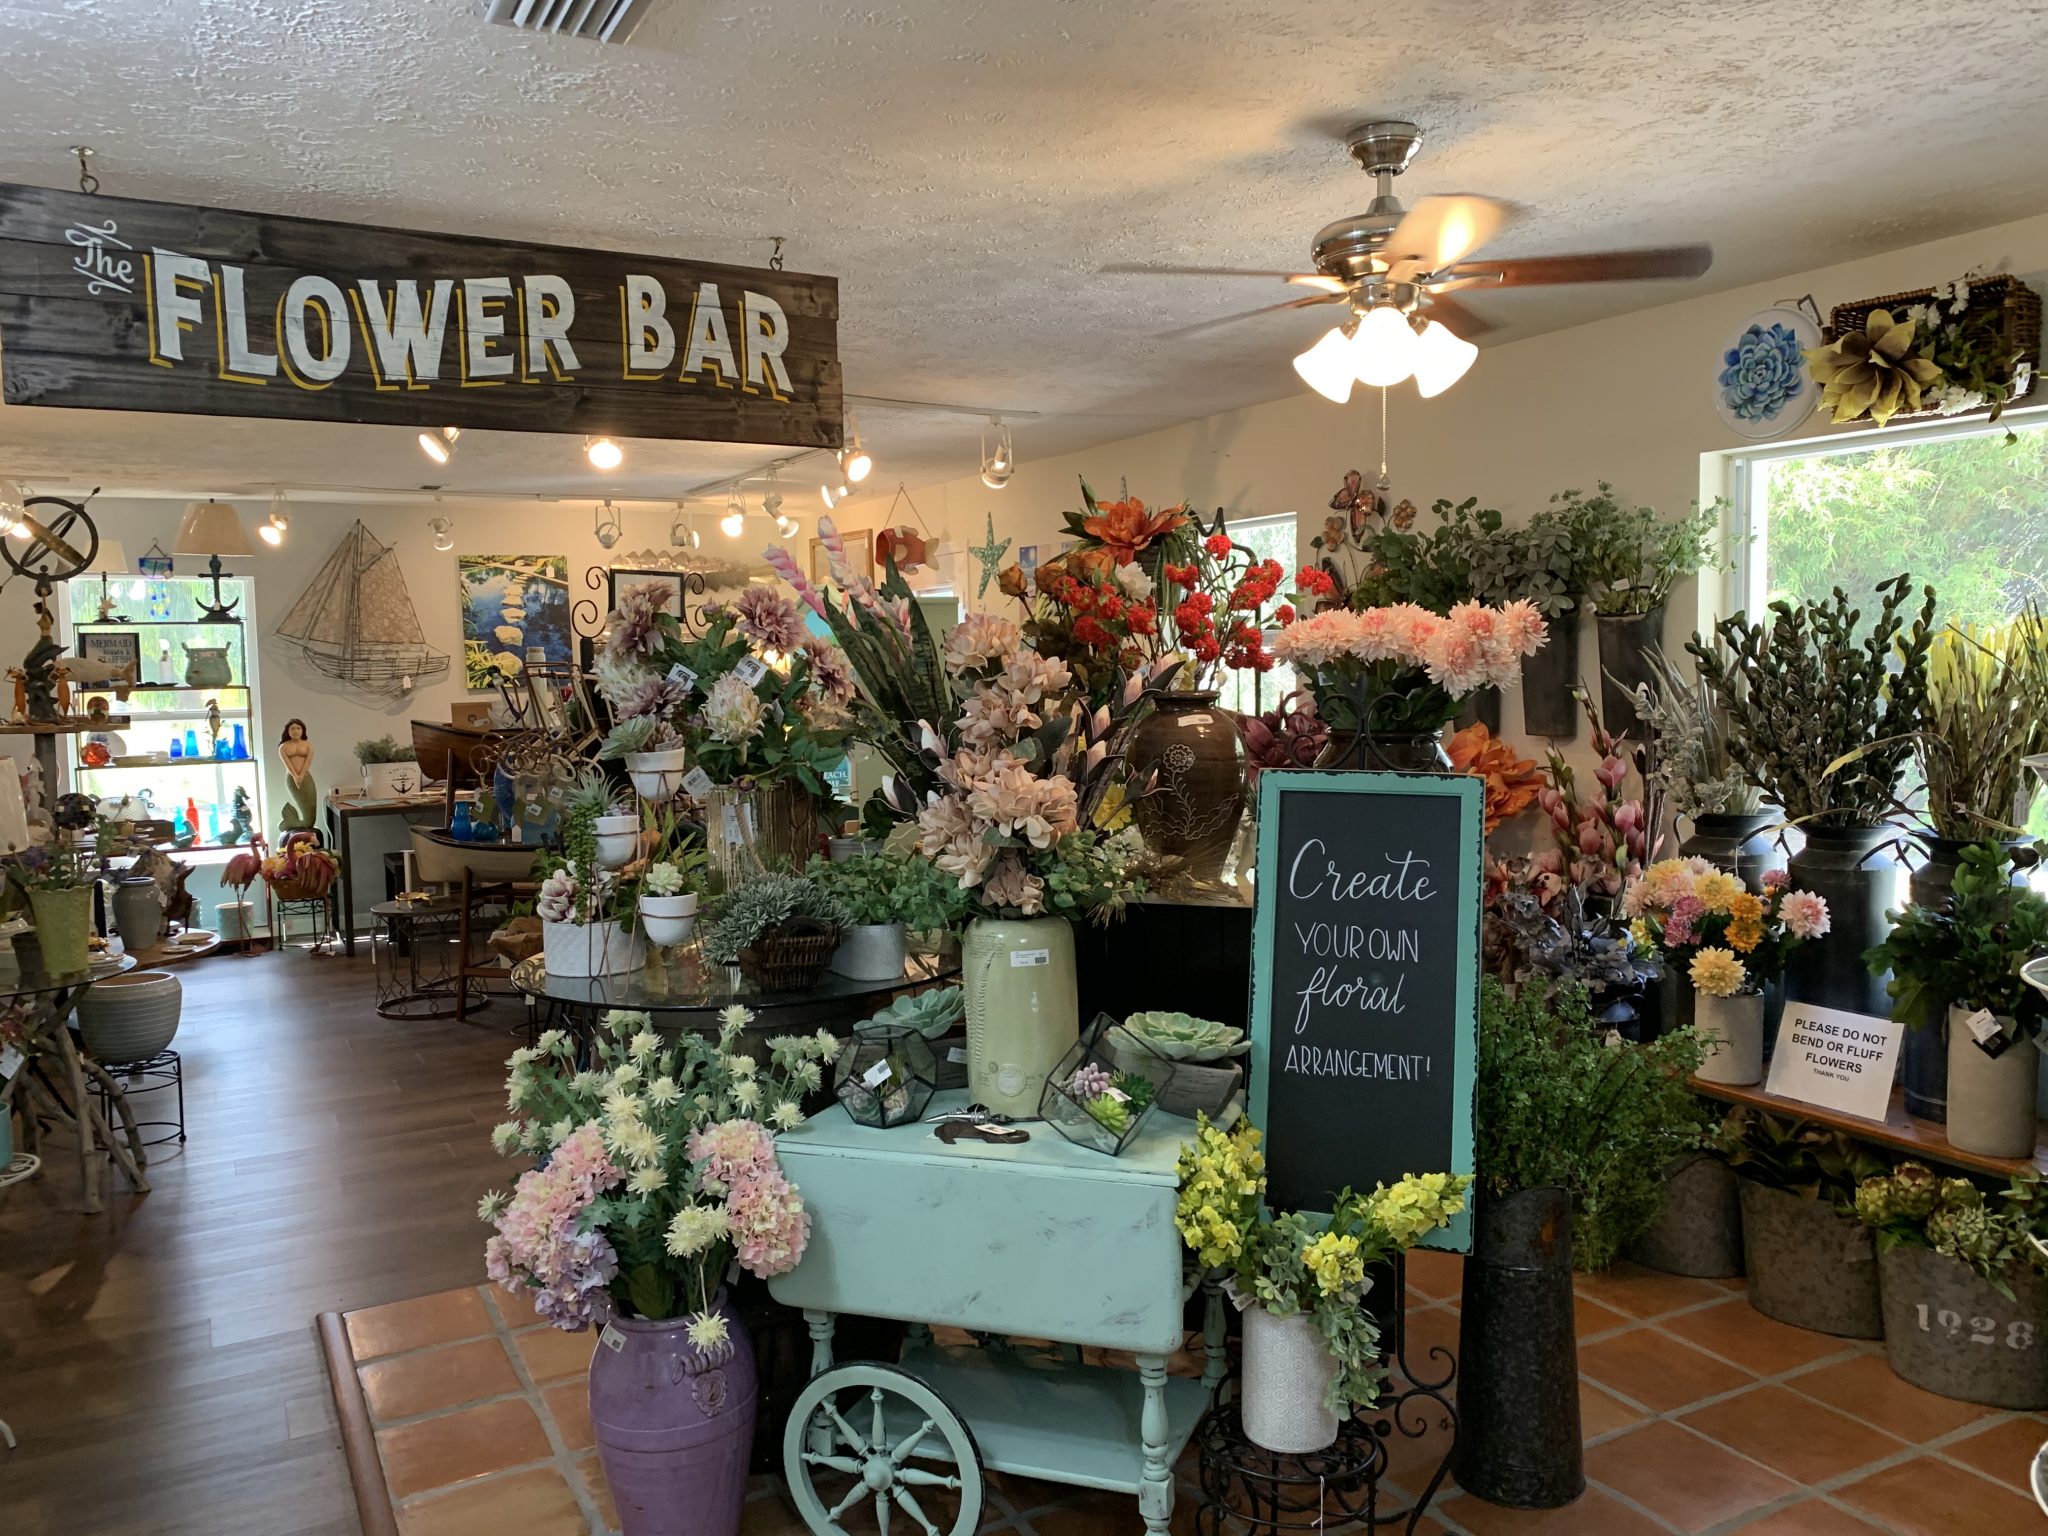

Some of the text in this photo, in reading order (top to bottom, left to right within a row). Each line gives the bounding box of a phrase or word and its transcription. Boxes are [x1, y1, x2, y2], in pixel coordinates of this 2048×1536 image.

[65, 228, 795, 403] The FLOWER BAR
[88, 639, 132, 648] MERMAID
[1289, 838, 1438, 901] Create
[1294, 922, 1419, 963] YOUR OWN
[1294, 964, 1406, 1035] floral
[1791, 1033, 1884, 1062] BEND OR FLUFF
[1794, 1018, 1887, 1047] PLEASE DO NOT
[1284, 1045, 1431, 1081] ARRANGEMENT!
[1805, 1052, 1862, 1074] FLOWERS
[1813, 1068, 1850, 1082] THANK YOU
[1916, 1303, 2034, 1350] 1928
